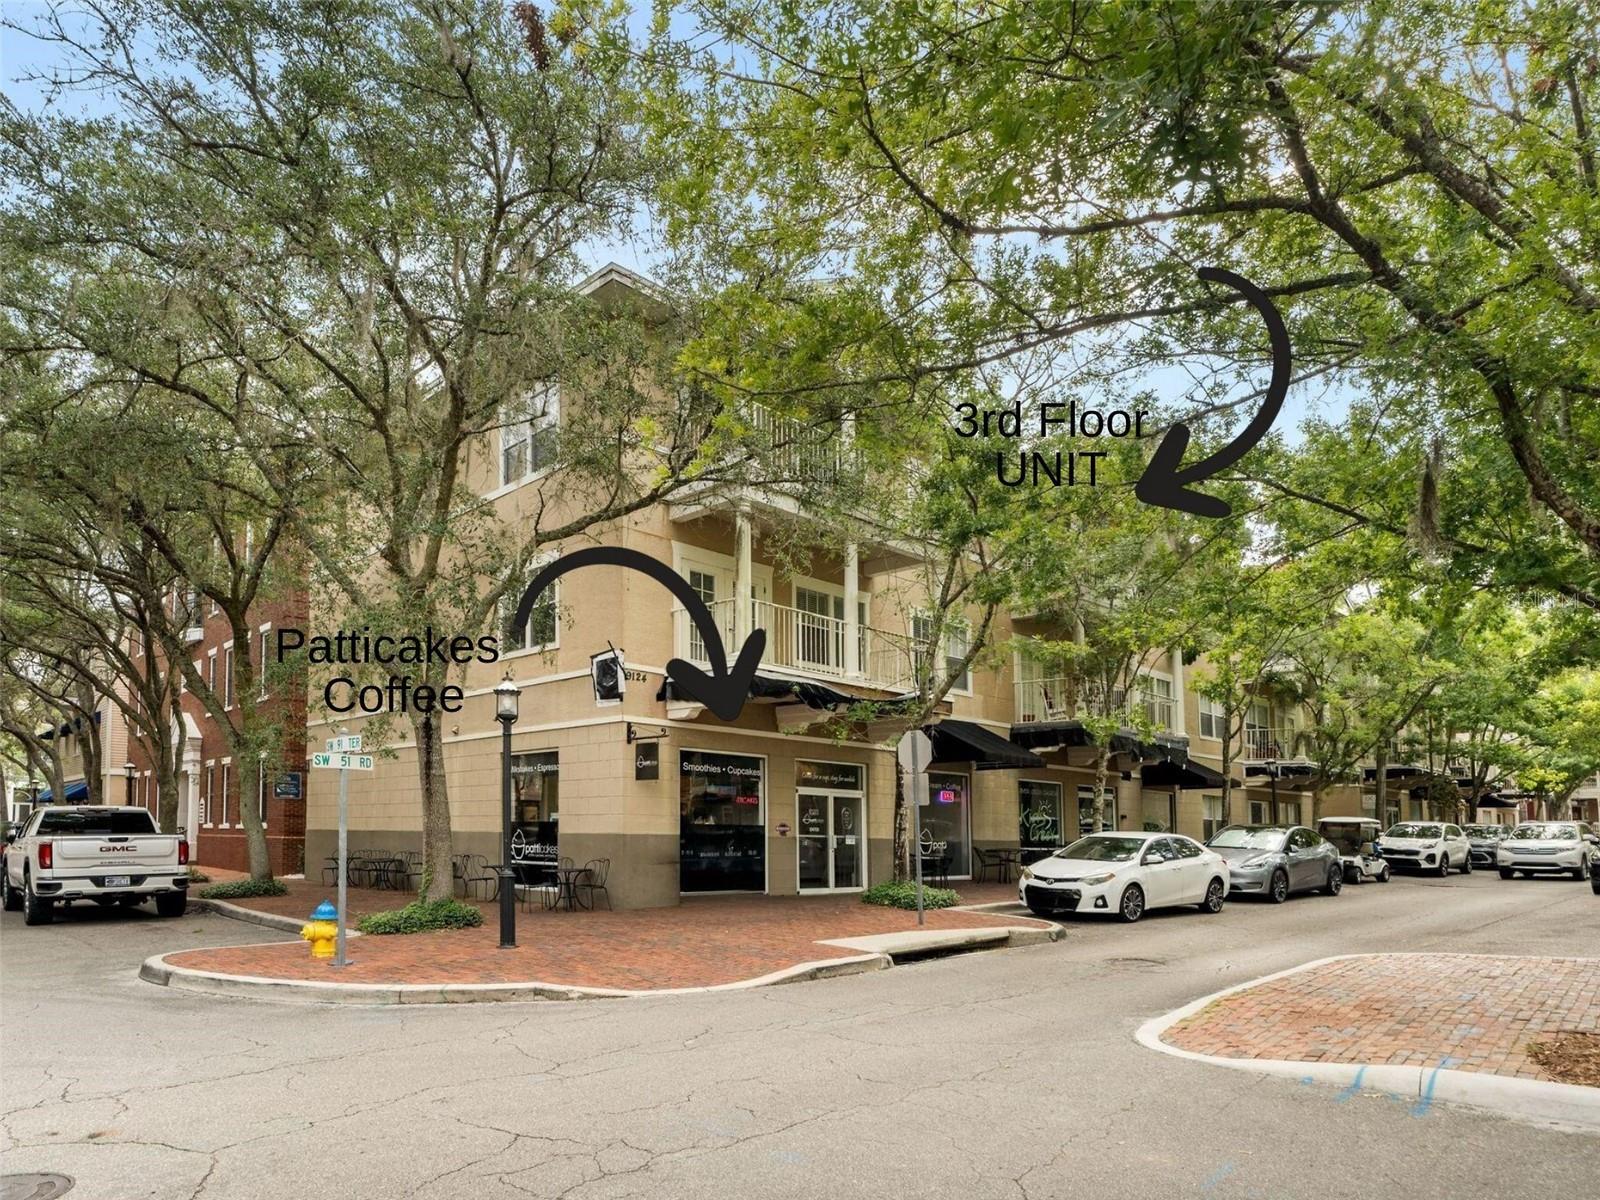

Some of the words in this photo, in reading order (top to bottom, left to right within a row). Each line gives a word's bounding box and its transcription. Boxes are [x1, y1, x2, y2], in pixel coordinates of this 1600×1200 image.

[348, 737, 360, 748] TER
[314, 754, 330, 766] SW
[341, 756, 350, 767] 51
[360, 757, 371, 768] RD
[682, 762, 721, 773] Smoothies
[727, 766, 760, 776] Cupcakes
[525, 843, 560, 855] patticakes
